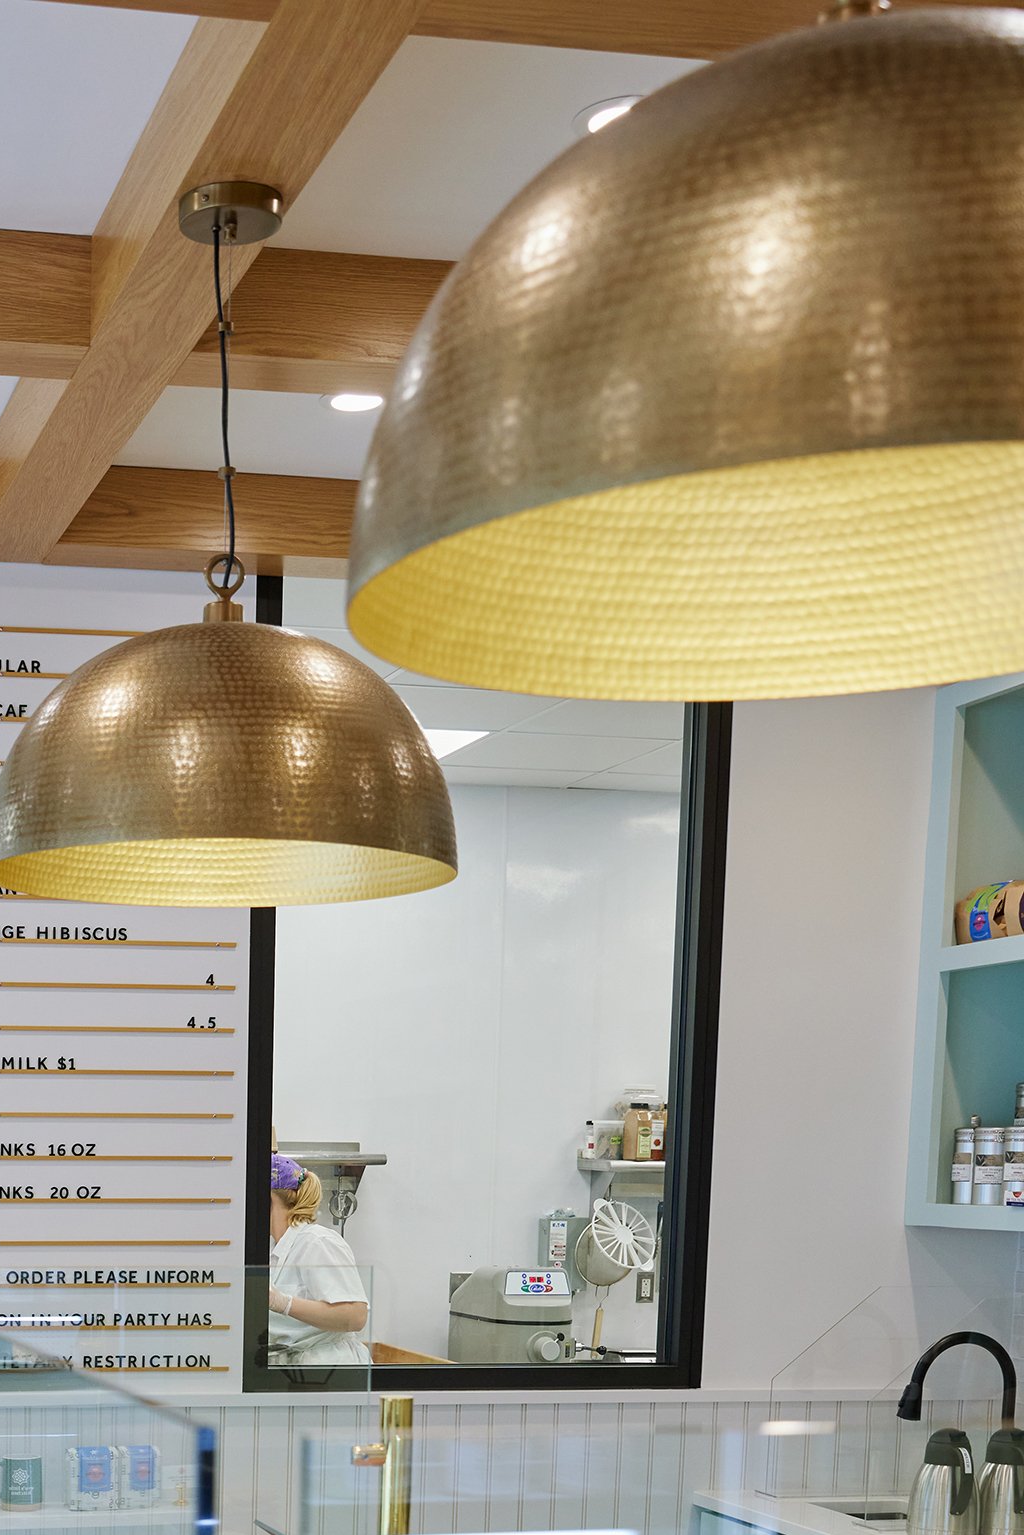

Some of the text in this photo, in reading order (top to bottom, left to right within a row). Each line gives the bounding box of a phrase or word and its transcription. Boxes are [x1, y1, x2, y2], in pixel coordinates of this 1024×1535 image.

[36, 926, 128, 941] HIBISCUS
[205, 973, 215, 986] 4
[186, 1016, 216, 1029] 4.5
[1, 1056, 48, 1071] MILK
[57, 1056, 76, 1071] $1
[48, 1143, 67, 1157] 16
[71, 1143, 96, 1157] OZ
[50, 1186, 69, 1200] 20
[76, 1185, 101, 1200] OZ
[6, 1270, 66, 1285] ORDER
[73, 1270, 138, 1285] PLEASE
[146, 1270, 214, 1284] INFORM
[31, 1313, 51, 1327] IN
[58, 1313, 106, 1327] YOUR
[113, 1313, 171, 1327] PARTY
[177, 1313, 212, 1327] HAS
[83, 1354, 211, 1369] RESTRICTION
